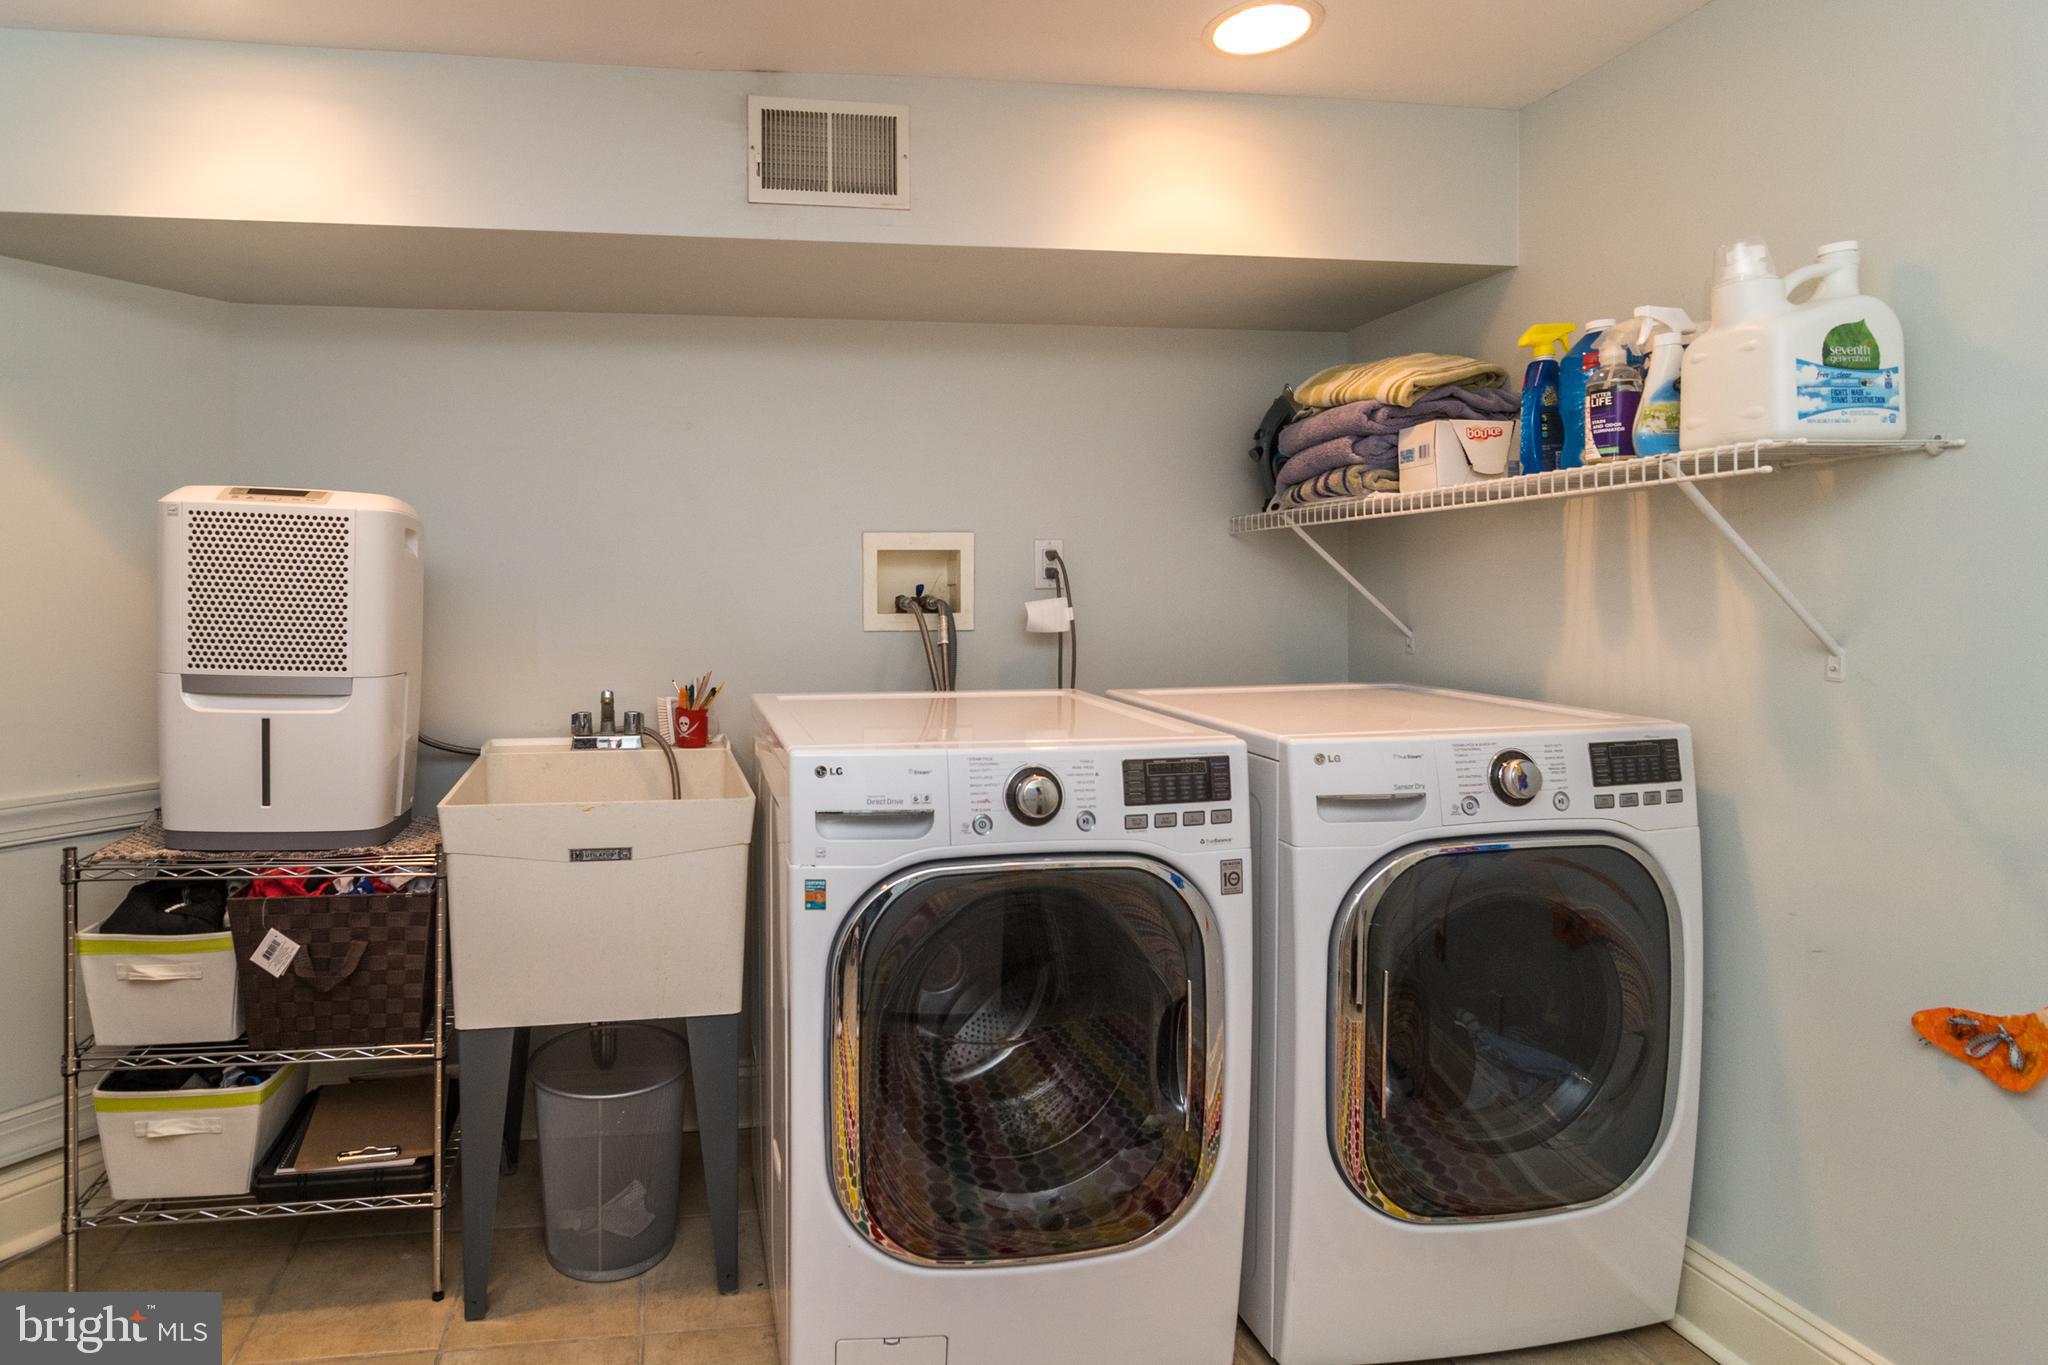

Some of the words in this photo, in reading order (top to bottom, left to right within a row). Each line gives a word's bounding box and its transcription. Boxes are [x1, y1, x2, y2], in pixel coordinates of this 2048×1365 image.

[1829, 345, 1871, 355] seventh
[1830, 355, 1871, 364] generation
[1591, 397, 1613, 407] LIFE
[1328, 755, 1341, 763] LG
[829, 767, 843, 776] LG
[1393, 783, 1414, 791] Sensor
[1414, 782, 1425, 790] Dry
[866, 797, 885, 806] Direct
[886, 798, 904, 806] Drive
